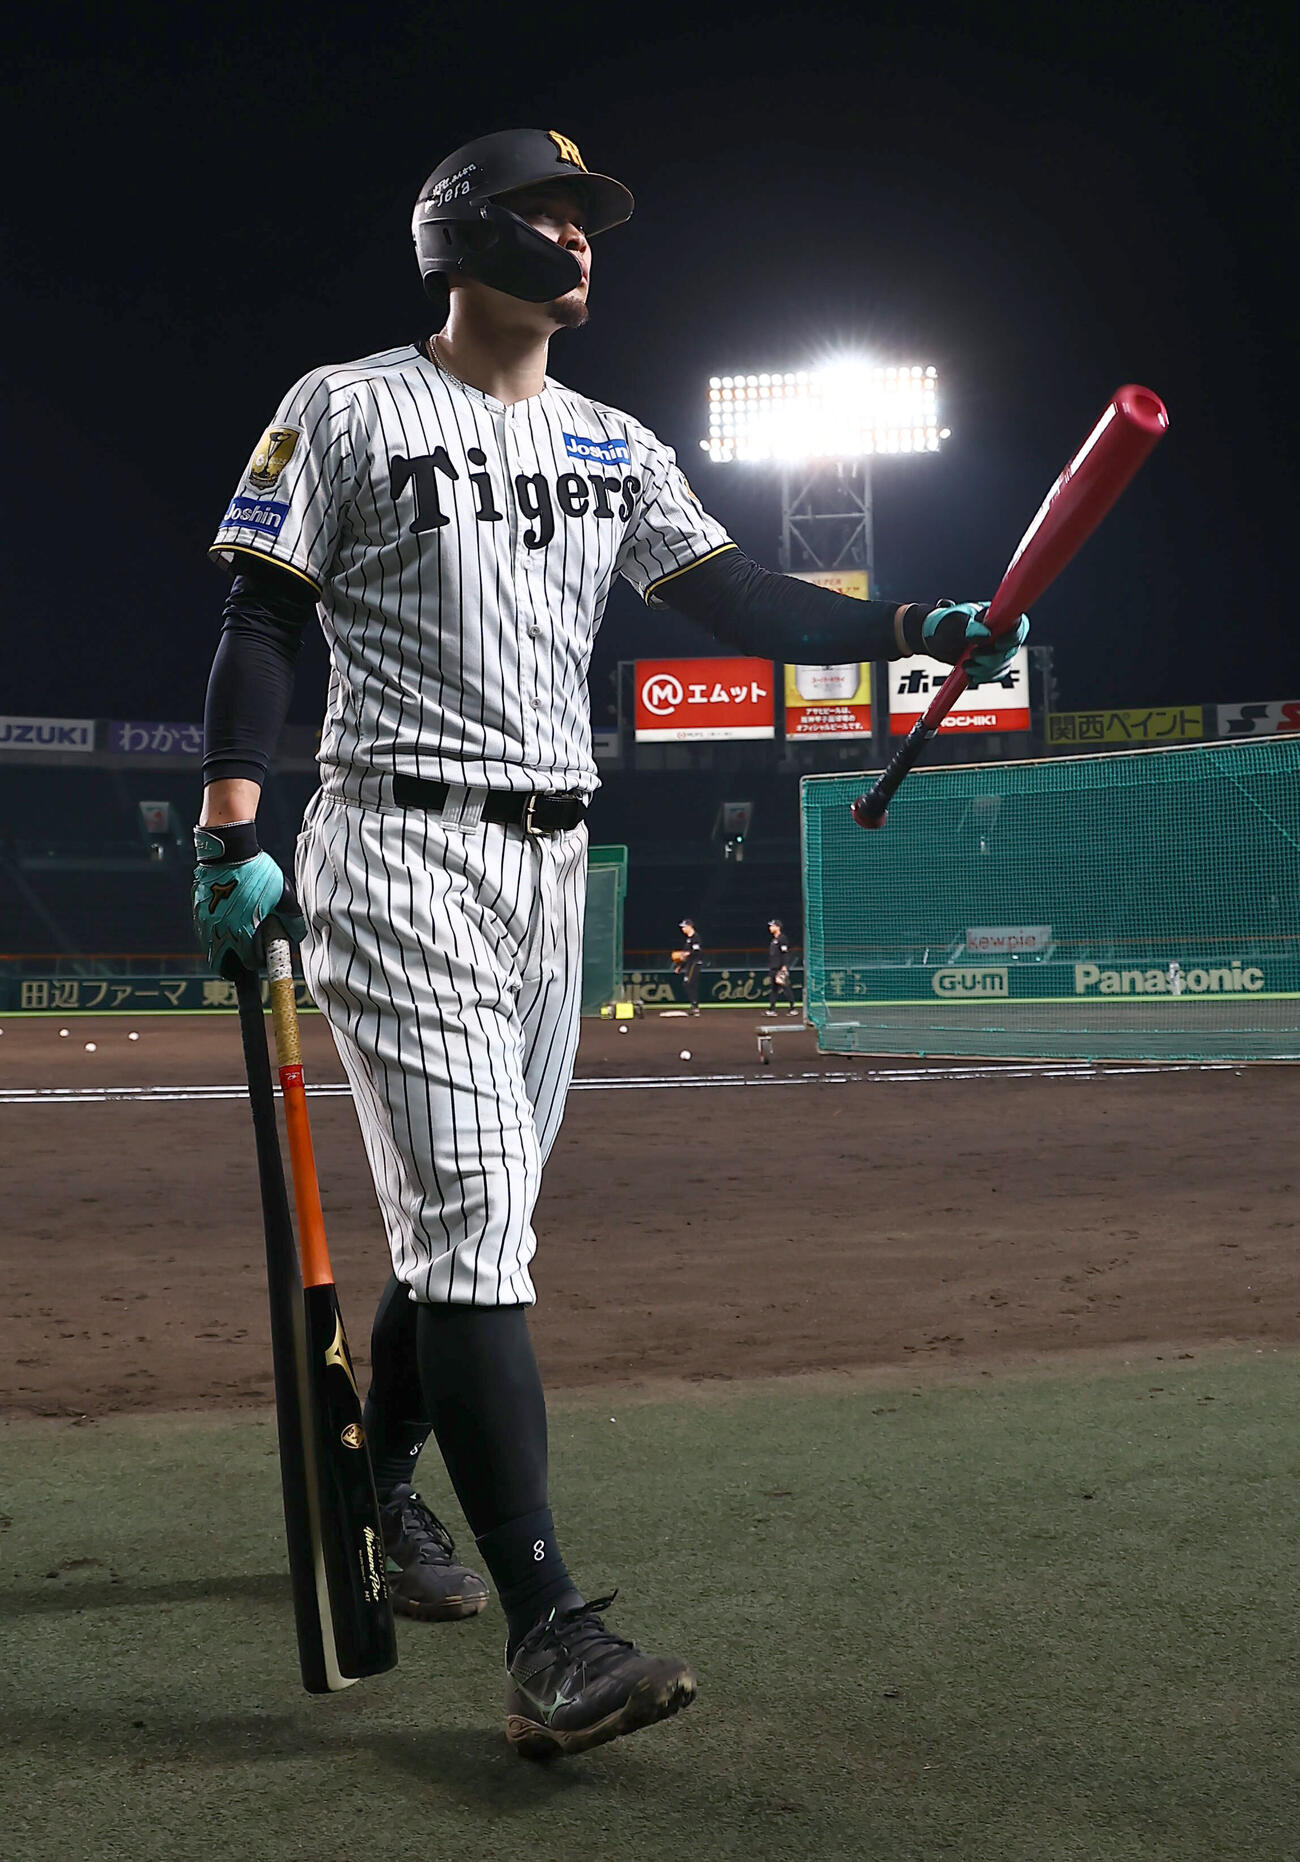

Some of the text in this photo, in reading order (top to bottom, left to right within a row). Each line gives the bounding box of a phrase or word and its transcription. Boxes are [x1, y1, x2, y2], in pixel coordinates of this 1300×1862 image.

[566, 438, 630, 461] Joshin
[390, 445, 641, 550] Tigers
[223, 504, 281, 528] Joshin
[687, 682, 767, 703] エムット
[1050, 710, 1200, 740] 関西ペイント
[968, 930, 1036, 953] kewpie
[1075, 961, 1265, 994] Panasonic
[21, 980, 188, 1009] 田辺ファーマ
[533, 1539, 545, 1561] 8
[363, 1525, 381, 1602] Mizuno Pro
